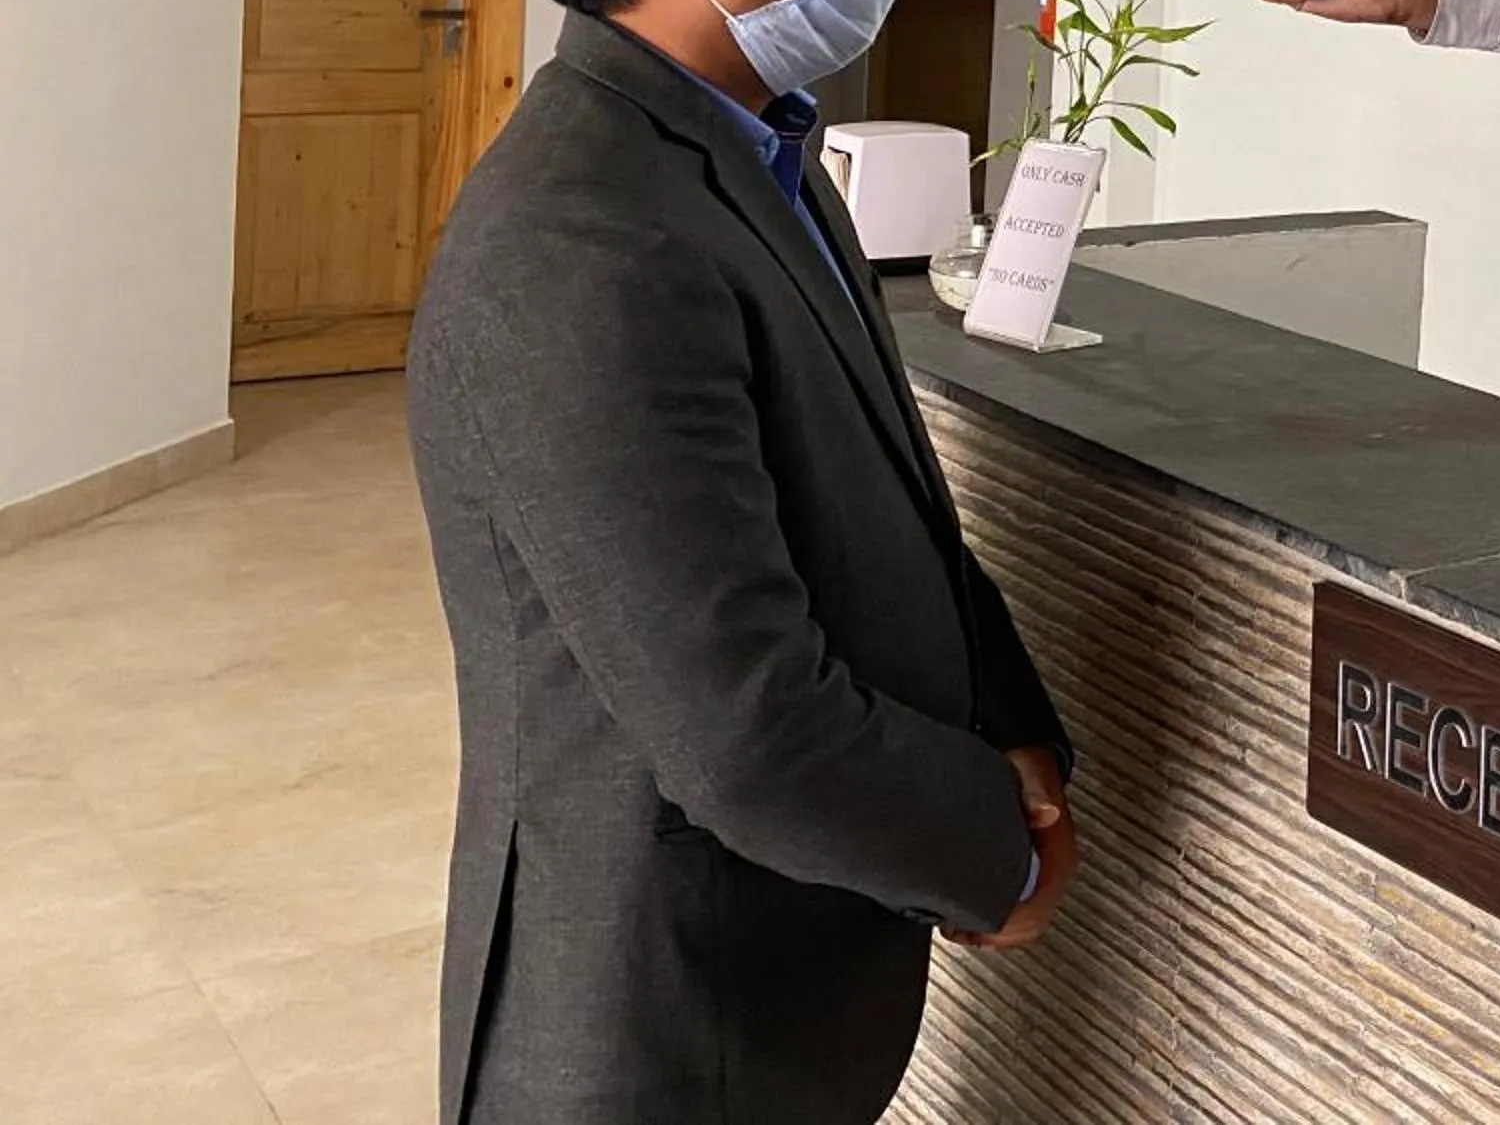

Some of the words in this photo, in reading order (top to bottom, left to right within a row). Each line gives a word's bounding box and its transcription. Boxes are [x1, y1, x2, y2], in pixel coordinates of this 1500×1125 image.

[1021, 165, 1054, 182] ONLY
[1052, 170, 1086, 187] CASH
[1003, 217, 1066, 238] ACCEPTED
